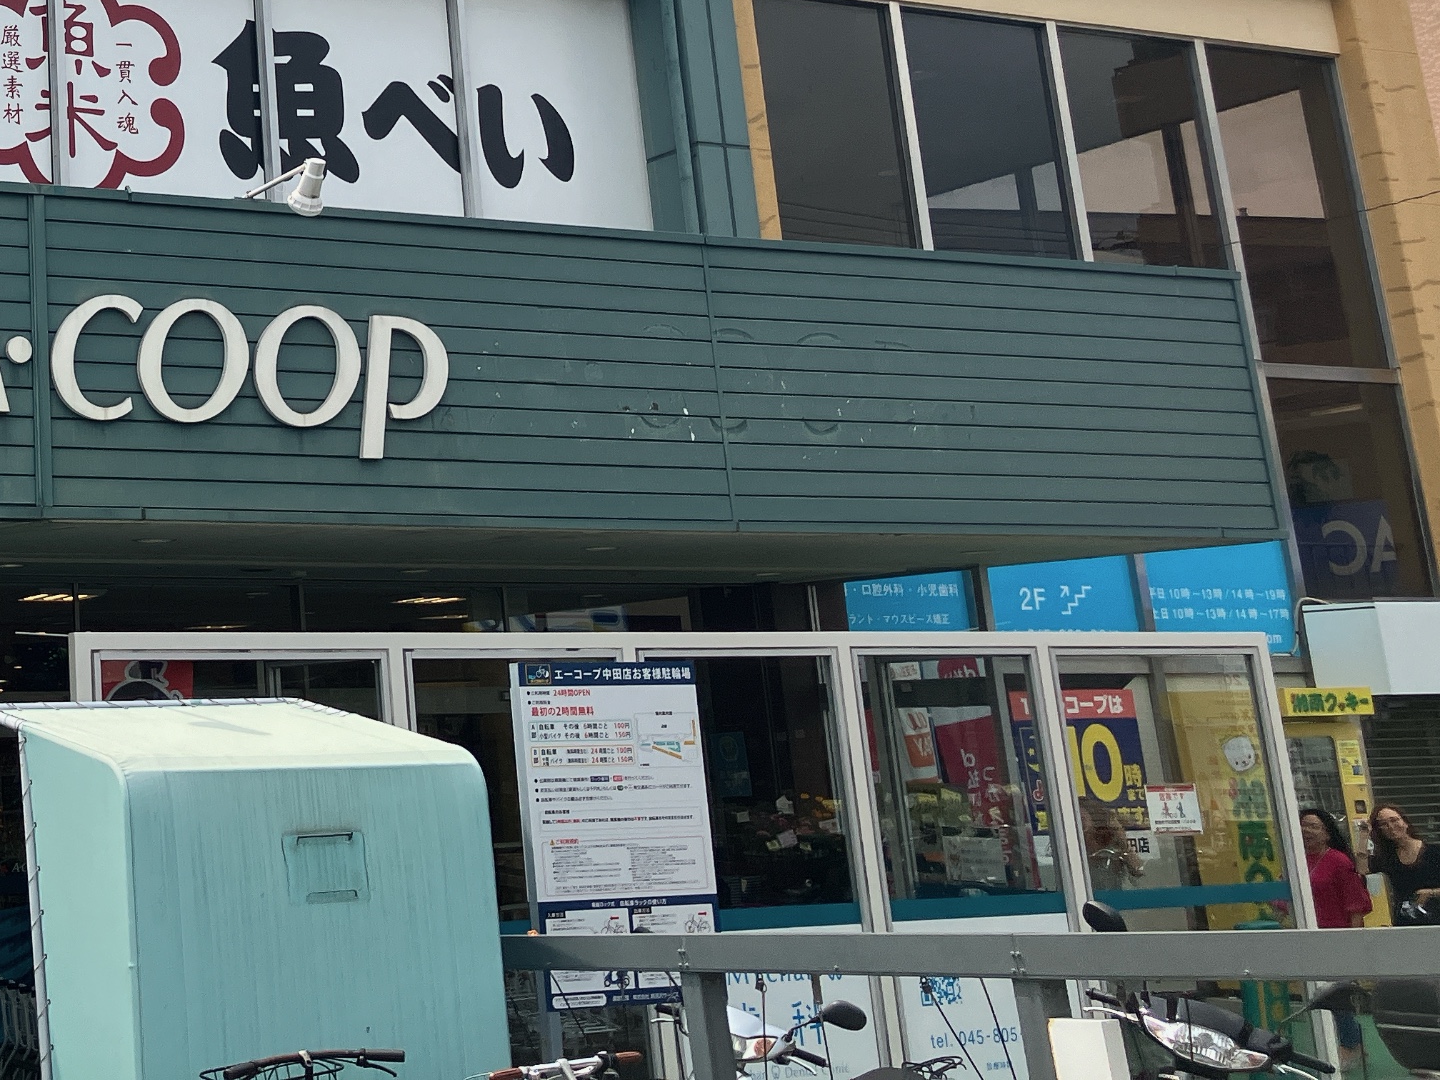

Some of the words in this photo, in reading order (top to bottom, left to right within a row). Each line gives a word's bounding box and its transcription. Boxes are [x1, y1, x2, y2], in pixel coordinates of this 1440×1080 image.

[0, 24, 24, 126] 厳選素材
[115, 41, 139, 135] 一貫入魂
[211, 18, 575, 189] 魚べい
[844, 582, 959, 598] ・口腔外科・小児歯科
[1018, 587, 1046, 611] 2F
[554, 666, 692, 681] エーコープ中田店お客様駐輪場
[531, 706, 594, 718] 最初の2時間無料
[1062, 694, 1124, 715] コープは
[930, 1032, 954, 1049] tel.
